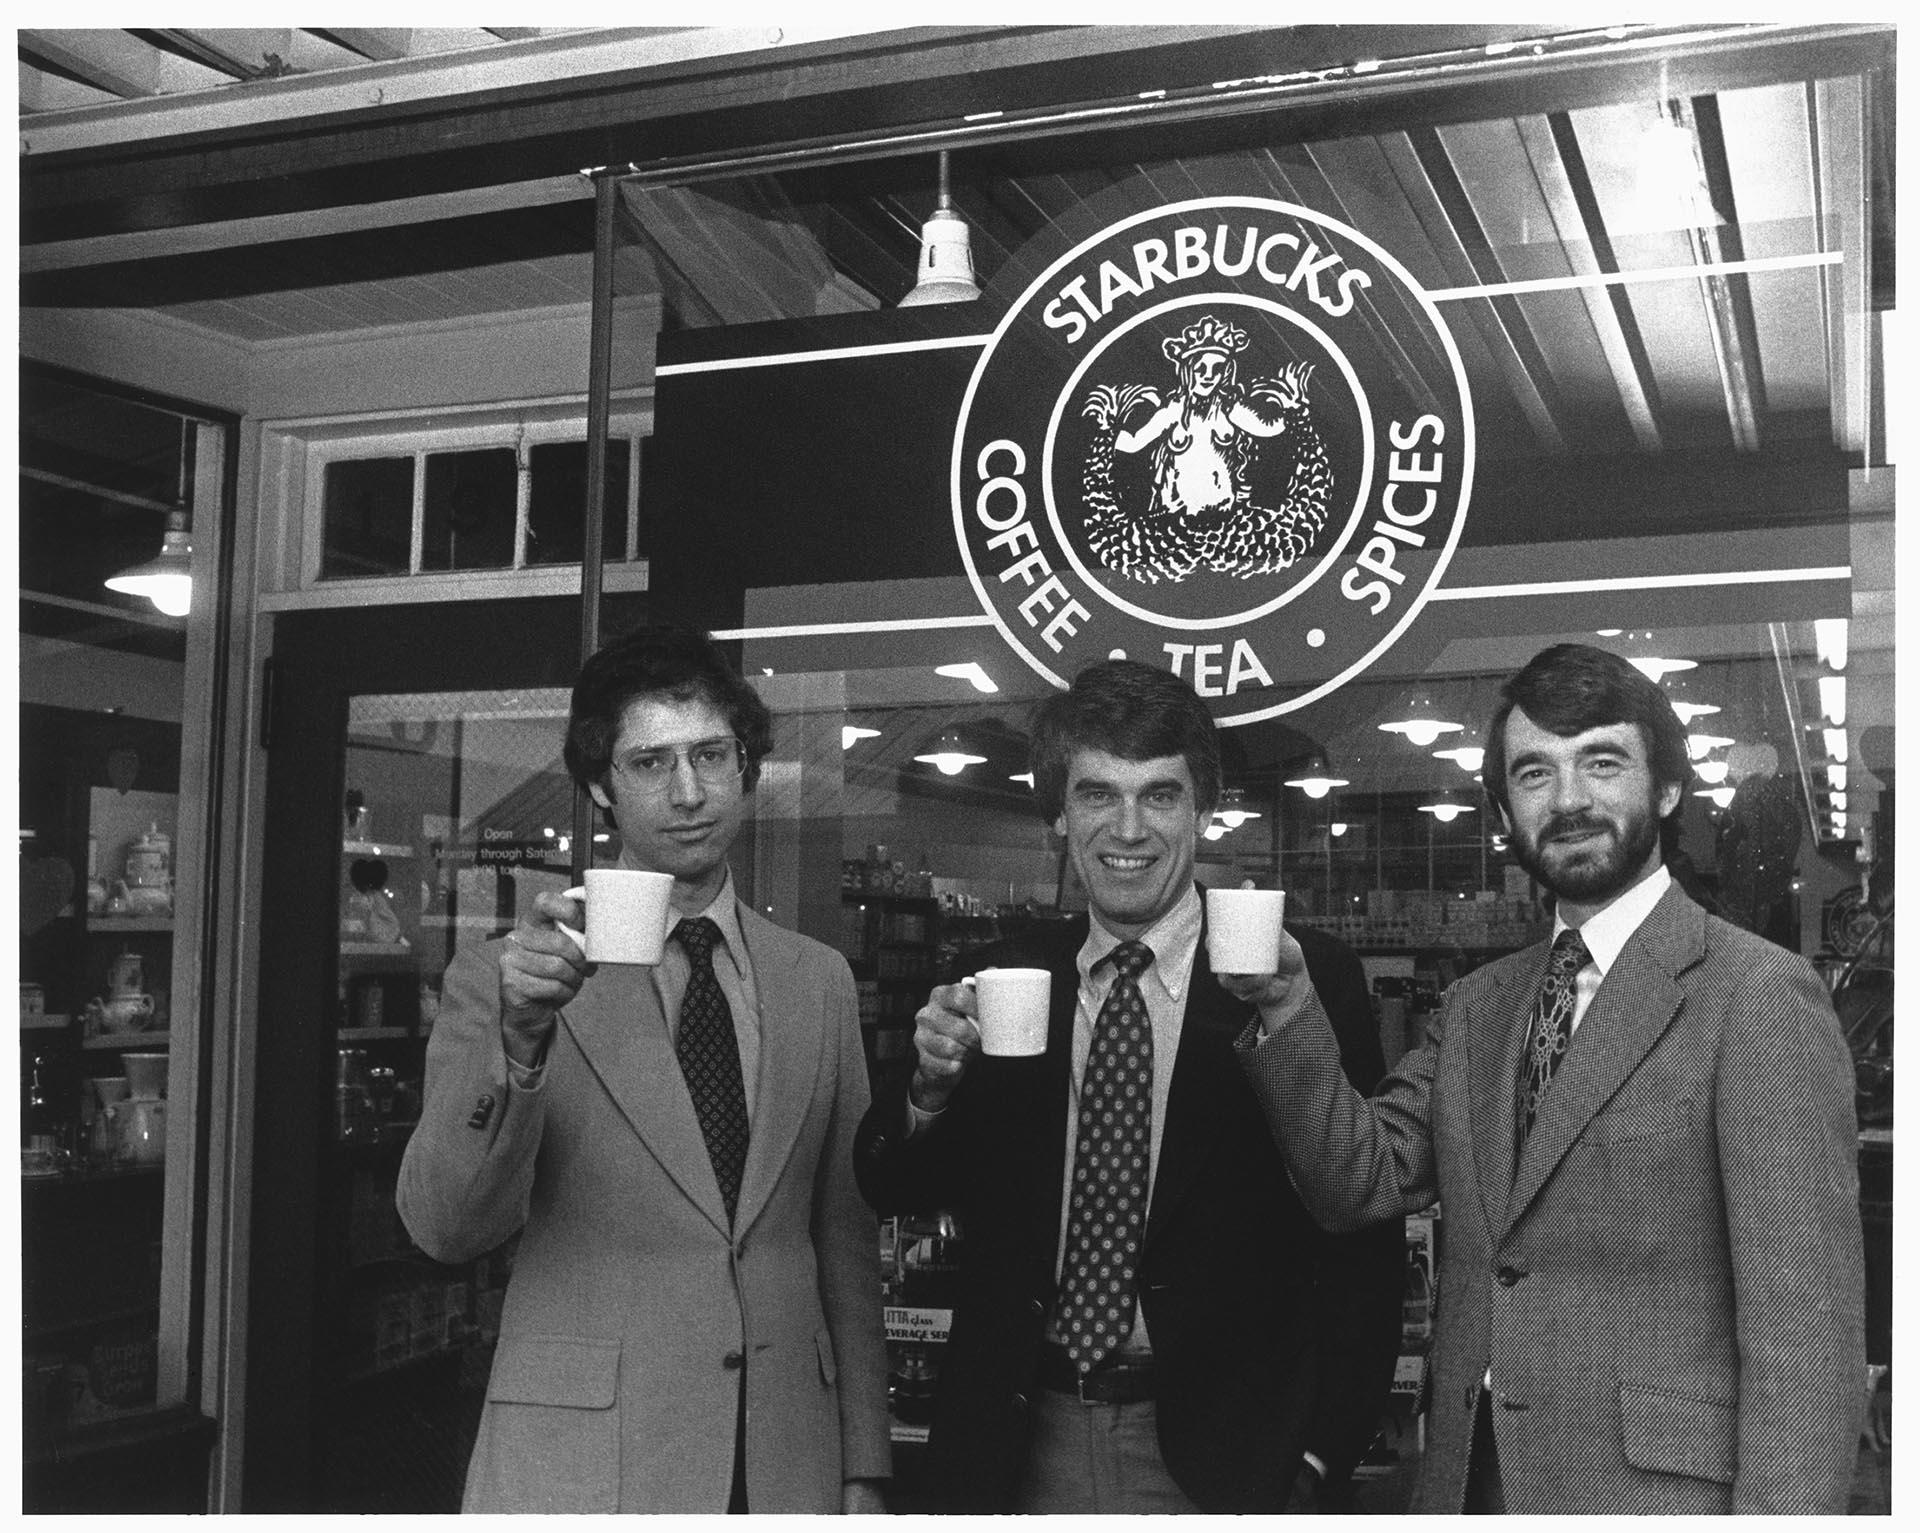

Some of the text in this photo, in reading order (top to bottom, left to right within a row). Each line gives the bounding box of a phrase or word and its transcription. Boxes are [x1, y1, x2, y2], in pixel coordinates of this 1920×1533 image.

[1042, 224, 1372, 344] STARBUCKS
[976, 439, 1092, 654] COFFEE
[1340, 414, 1445, 616] SPICES
[1162, 638, 1274, 697] TEA
[480, 847, 522, 861] through
[483, 827, 513, 841] Open
